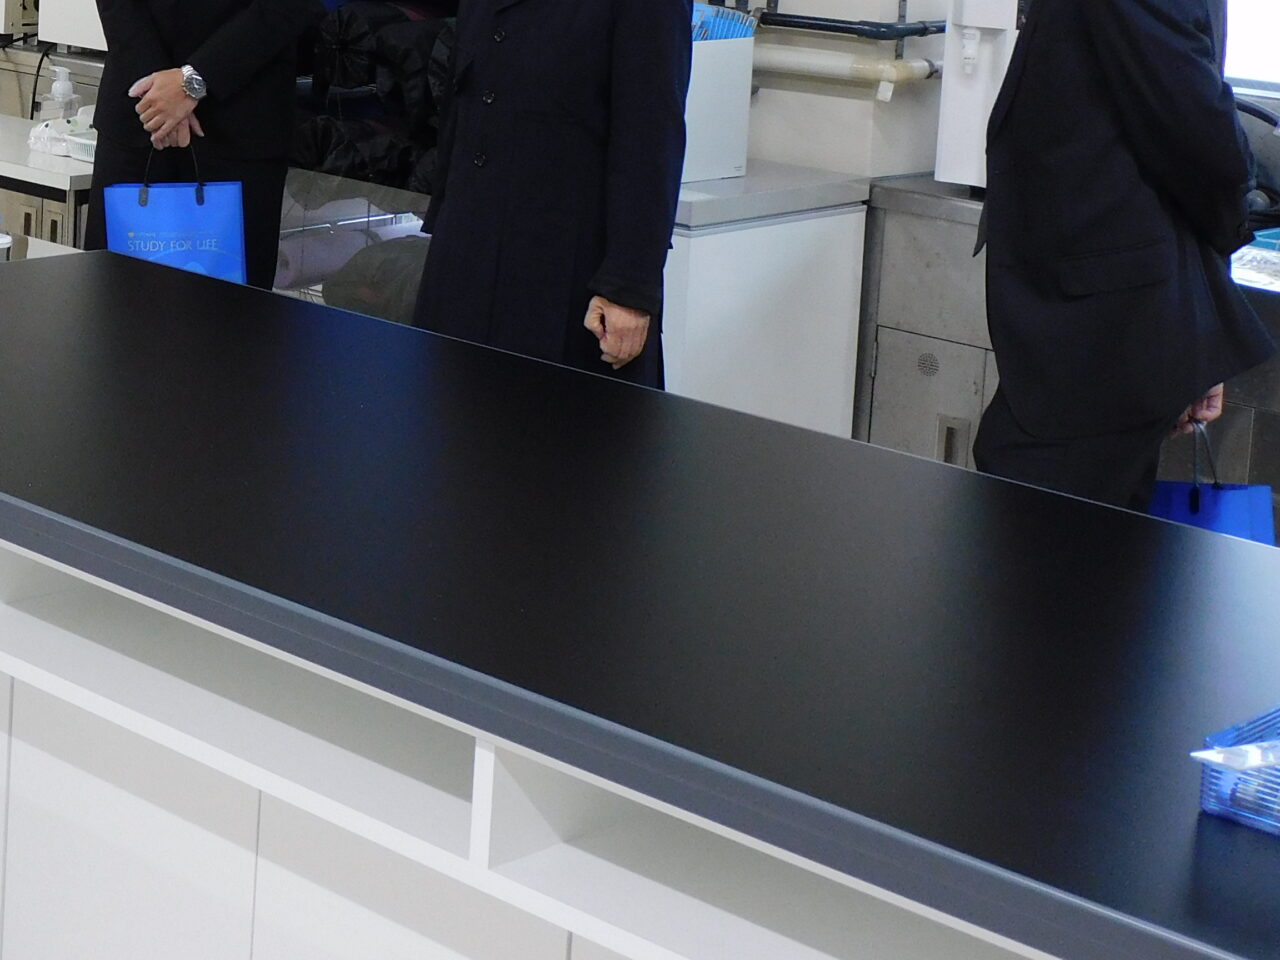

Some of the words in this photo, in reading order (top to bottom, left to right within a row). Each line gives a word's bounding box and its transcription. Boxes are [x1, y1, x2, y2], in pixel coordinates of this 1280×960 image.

[128, 240, 166, 252] STUDY
[170, 240, 192, 250] FOR
[197, 238, 218, 250] LIFE
